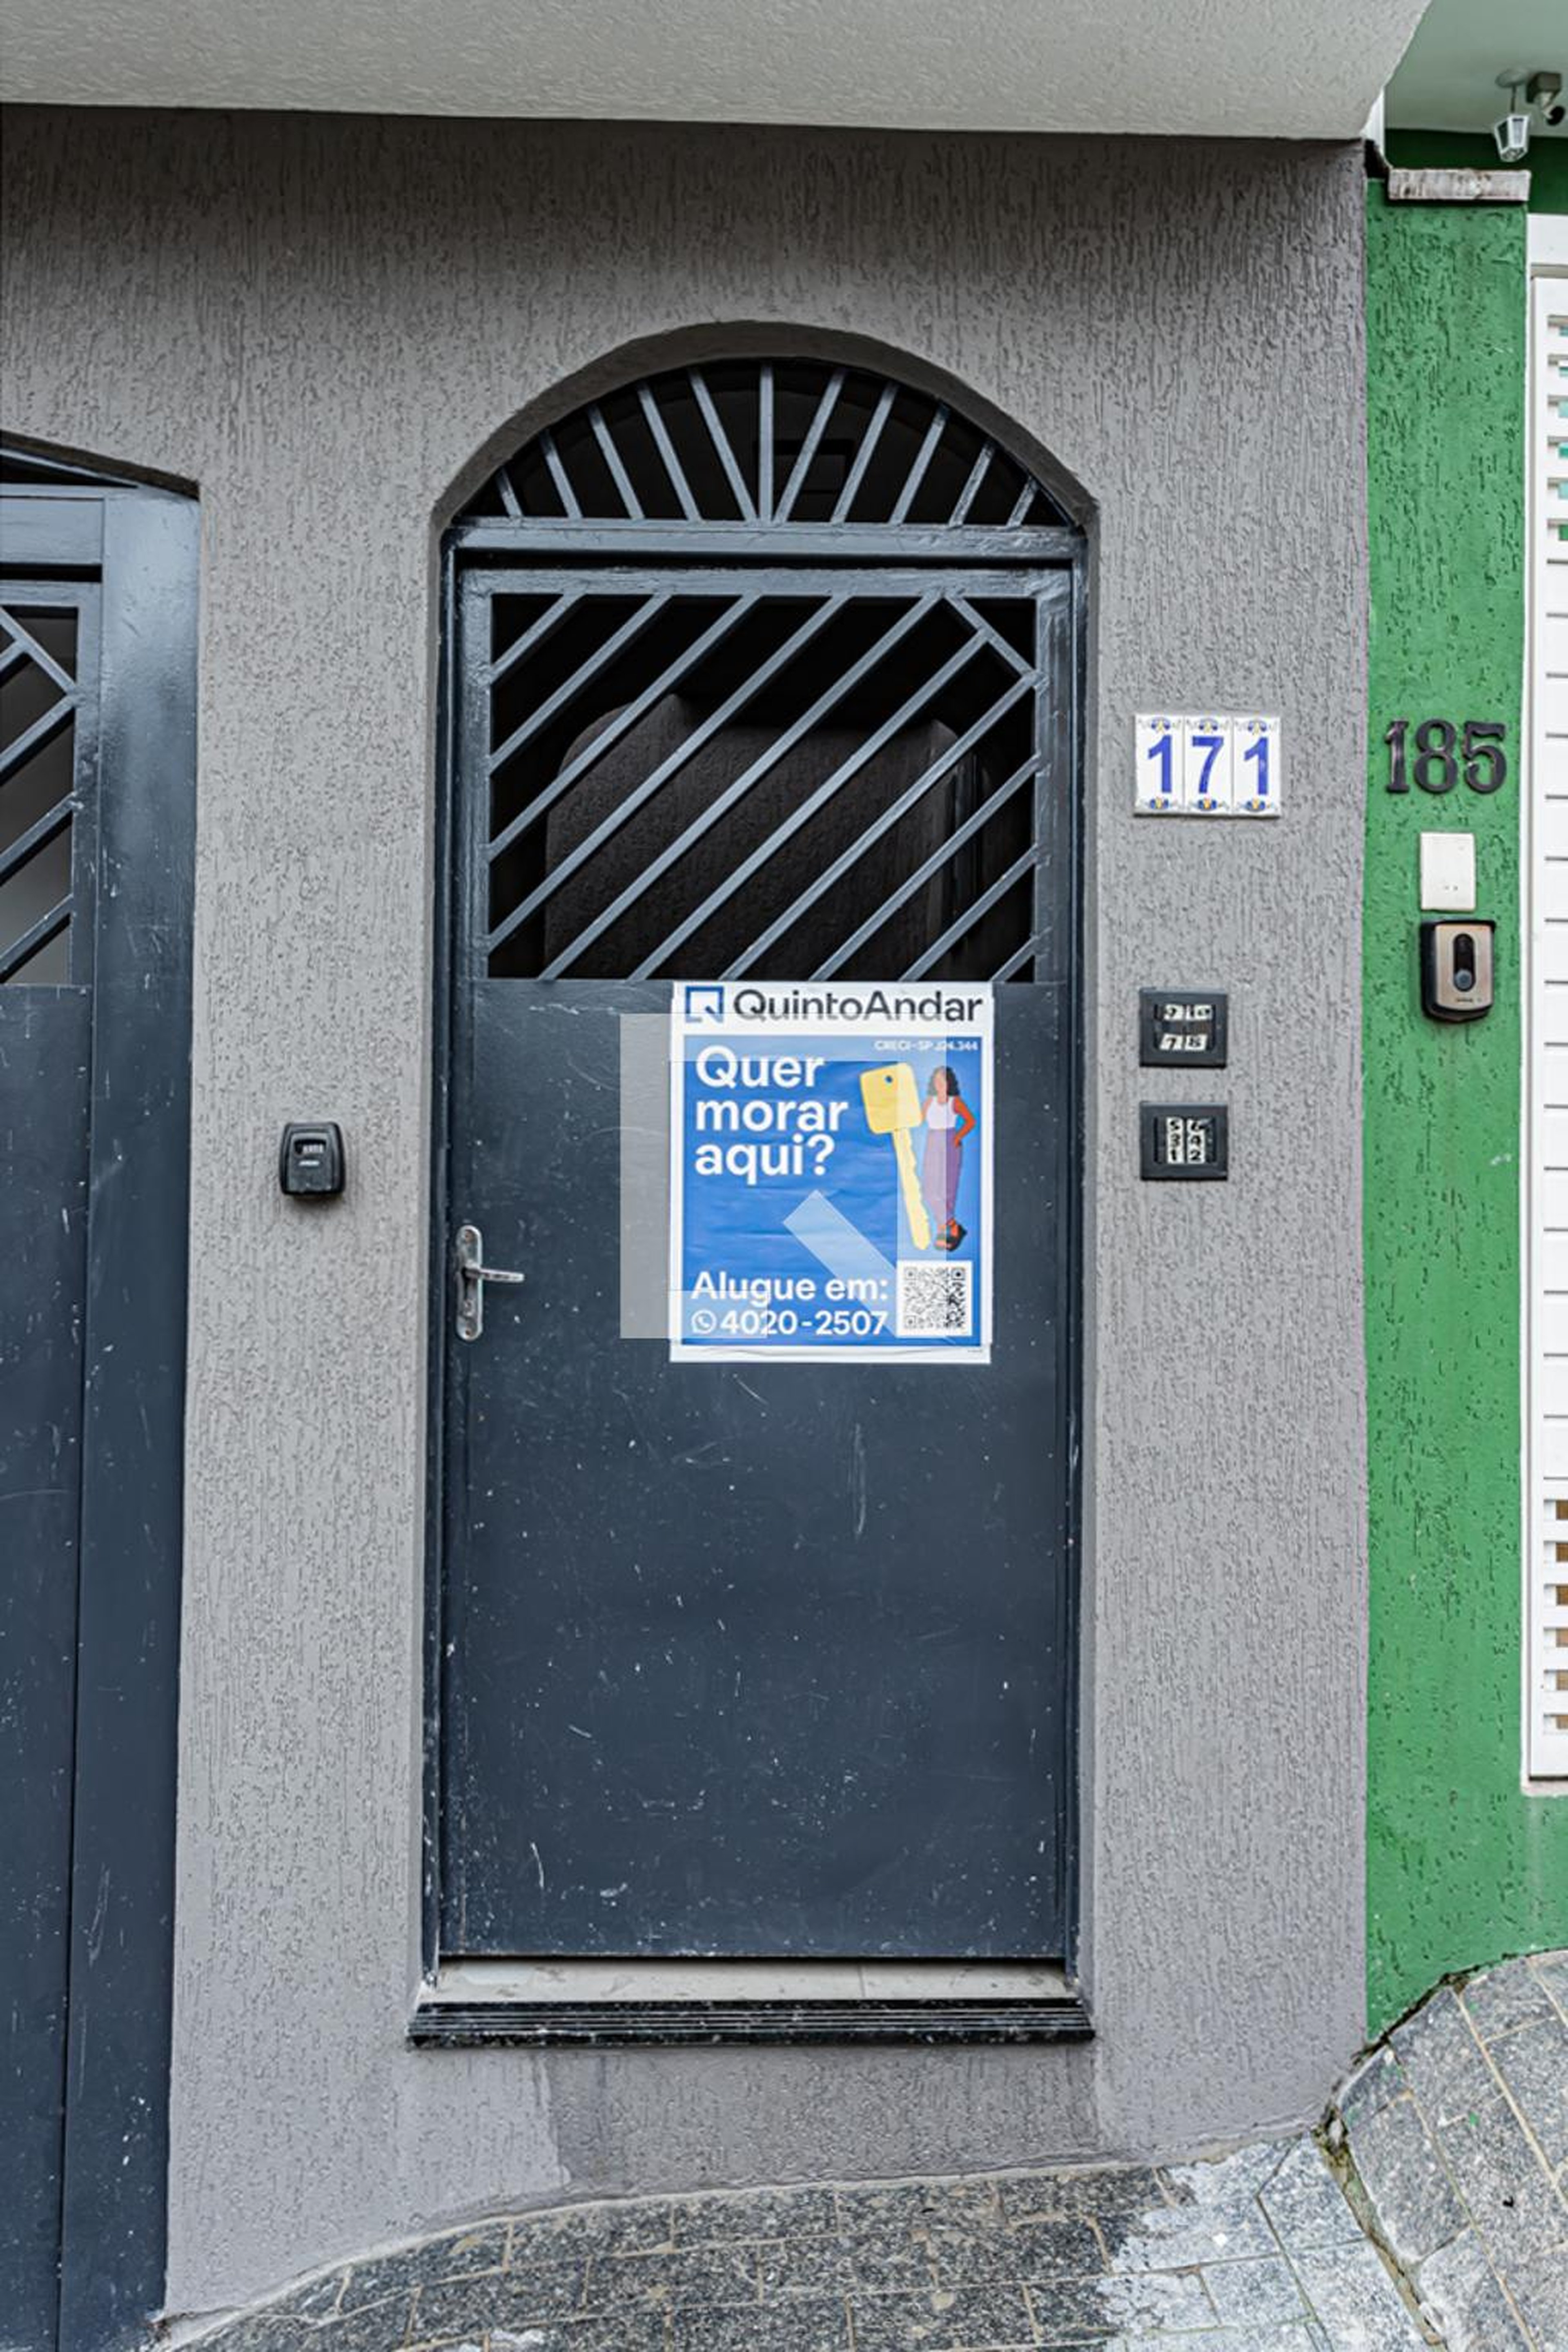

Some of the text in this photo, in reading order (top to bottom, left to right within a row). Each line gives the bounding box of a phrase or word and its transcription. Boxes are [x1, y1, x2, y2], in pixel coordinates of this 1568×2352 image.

[1147, 734, 1269, 795] 171
[1384, 719, 1507, 795] 185
[734, 989, 982, 1022] QuintoAndar
[696, 1045, 825, 1089] Quer
[696, 1100, 849, 1131] morar
[695, 1133, 835, 1186] aqui?
[691, 1271, 888, 1307] Alugue em:
